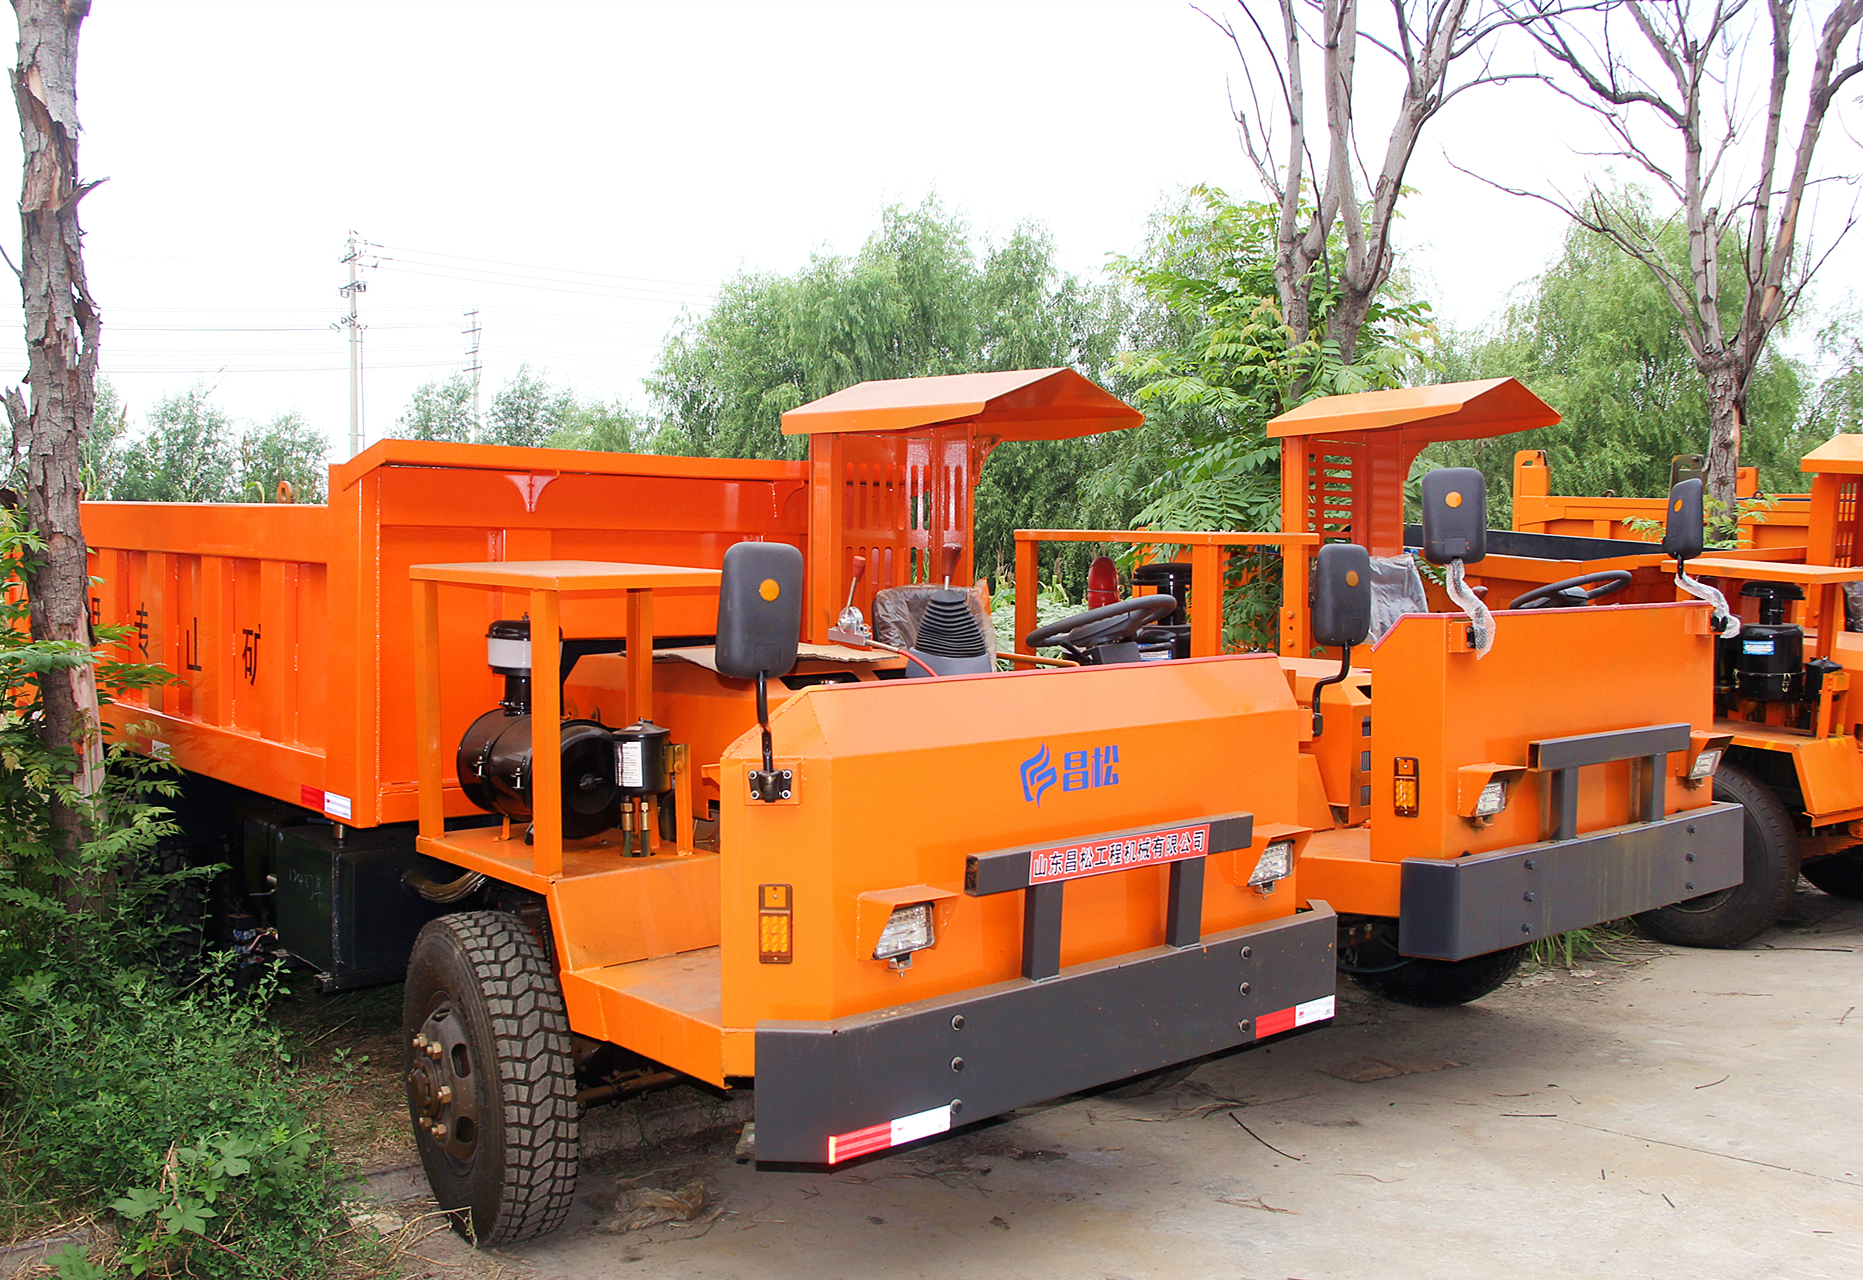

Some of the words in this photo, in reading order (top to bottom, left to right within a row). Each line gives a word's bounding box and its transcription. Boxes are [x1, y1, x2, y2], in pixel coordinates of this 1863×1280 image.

[1062, 744, 1120, 792] 昌松
[1033, 829, 1206, 878] 山东昌松工程机械有限公司
